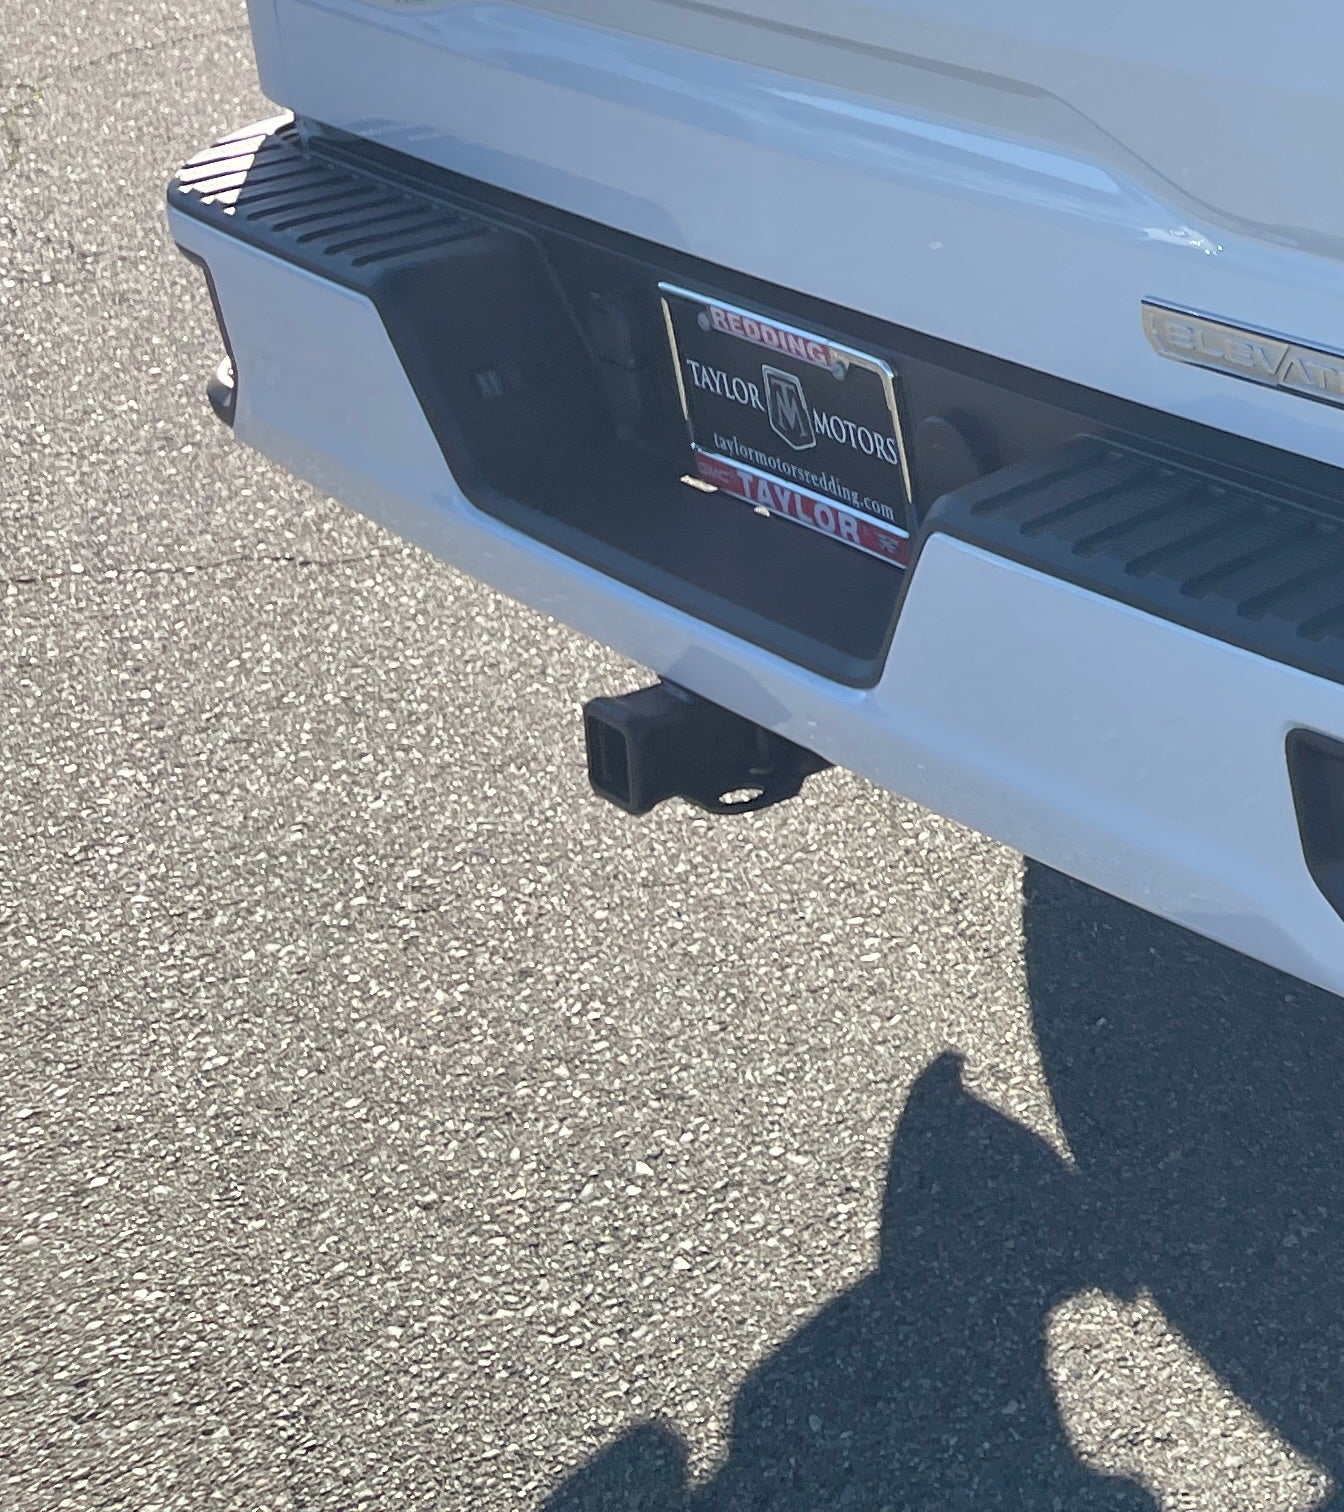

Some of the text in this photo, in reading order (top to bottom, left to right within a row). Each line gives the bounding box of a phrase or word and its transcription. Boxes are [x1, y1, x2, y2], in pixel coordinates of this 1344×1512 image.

[710, 305, 829, 368] REDDING
[686, 358, 898, 466] TAYLOR MOTORS
[713, 432, 896, 522] taylormotorsredding.com
[736, 468, 861, 545] TAYLOR
